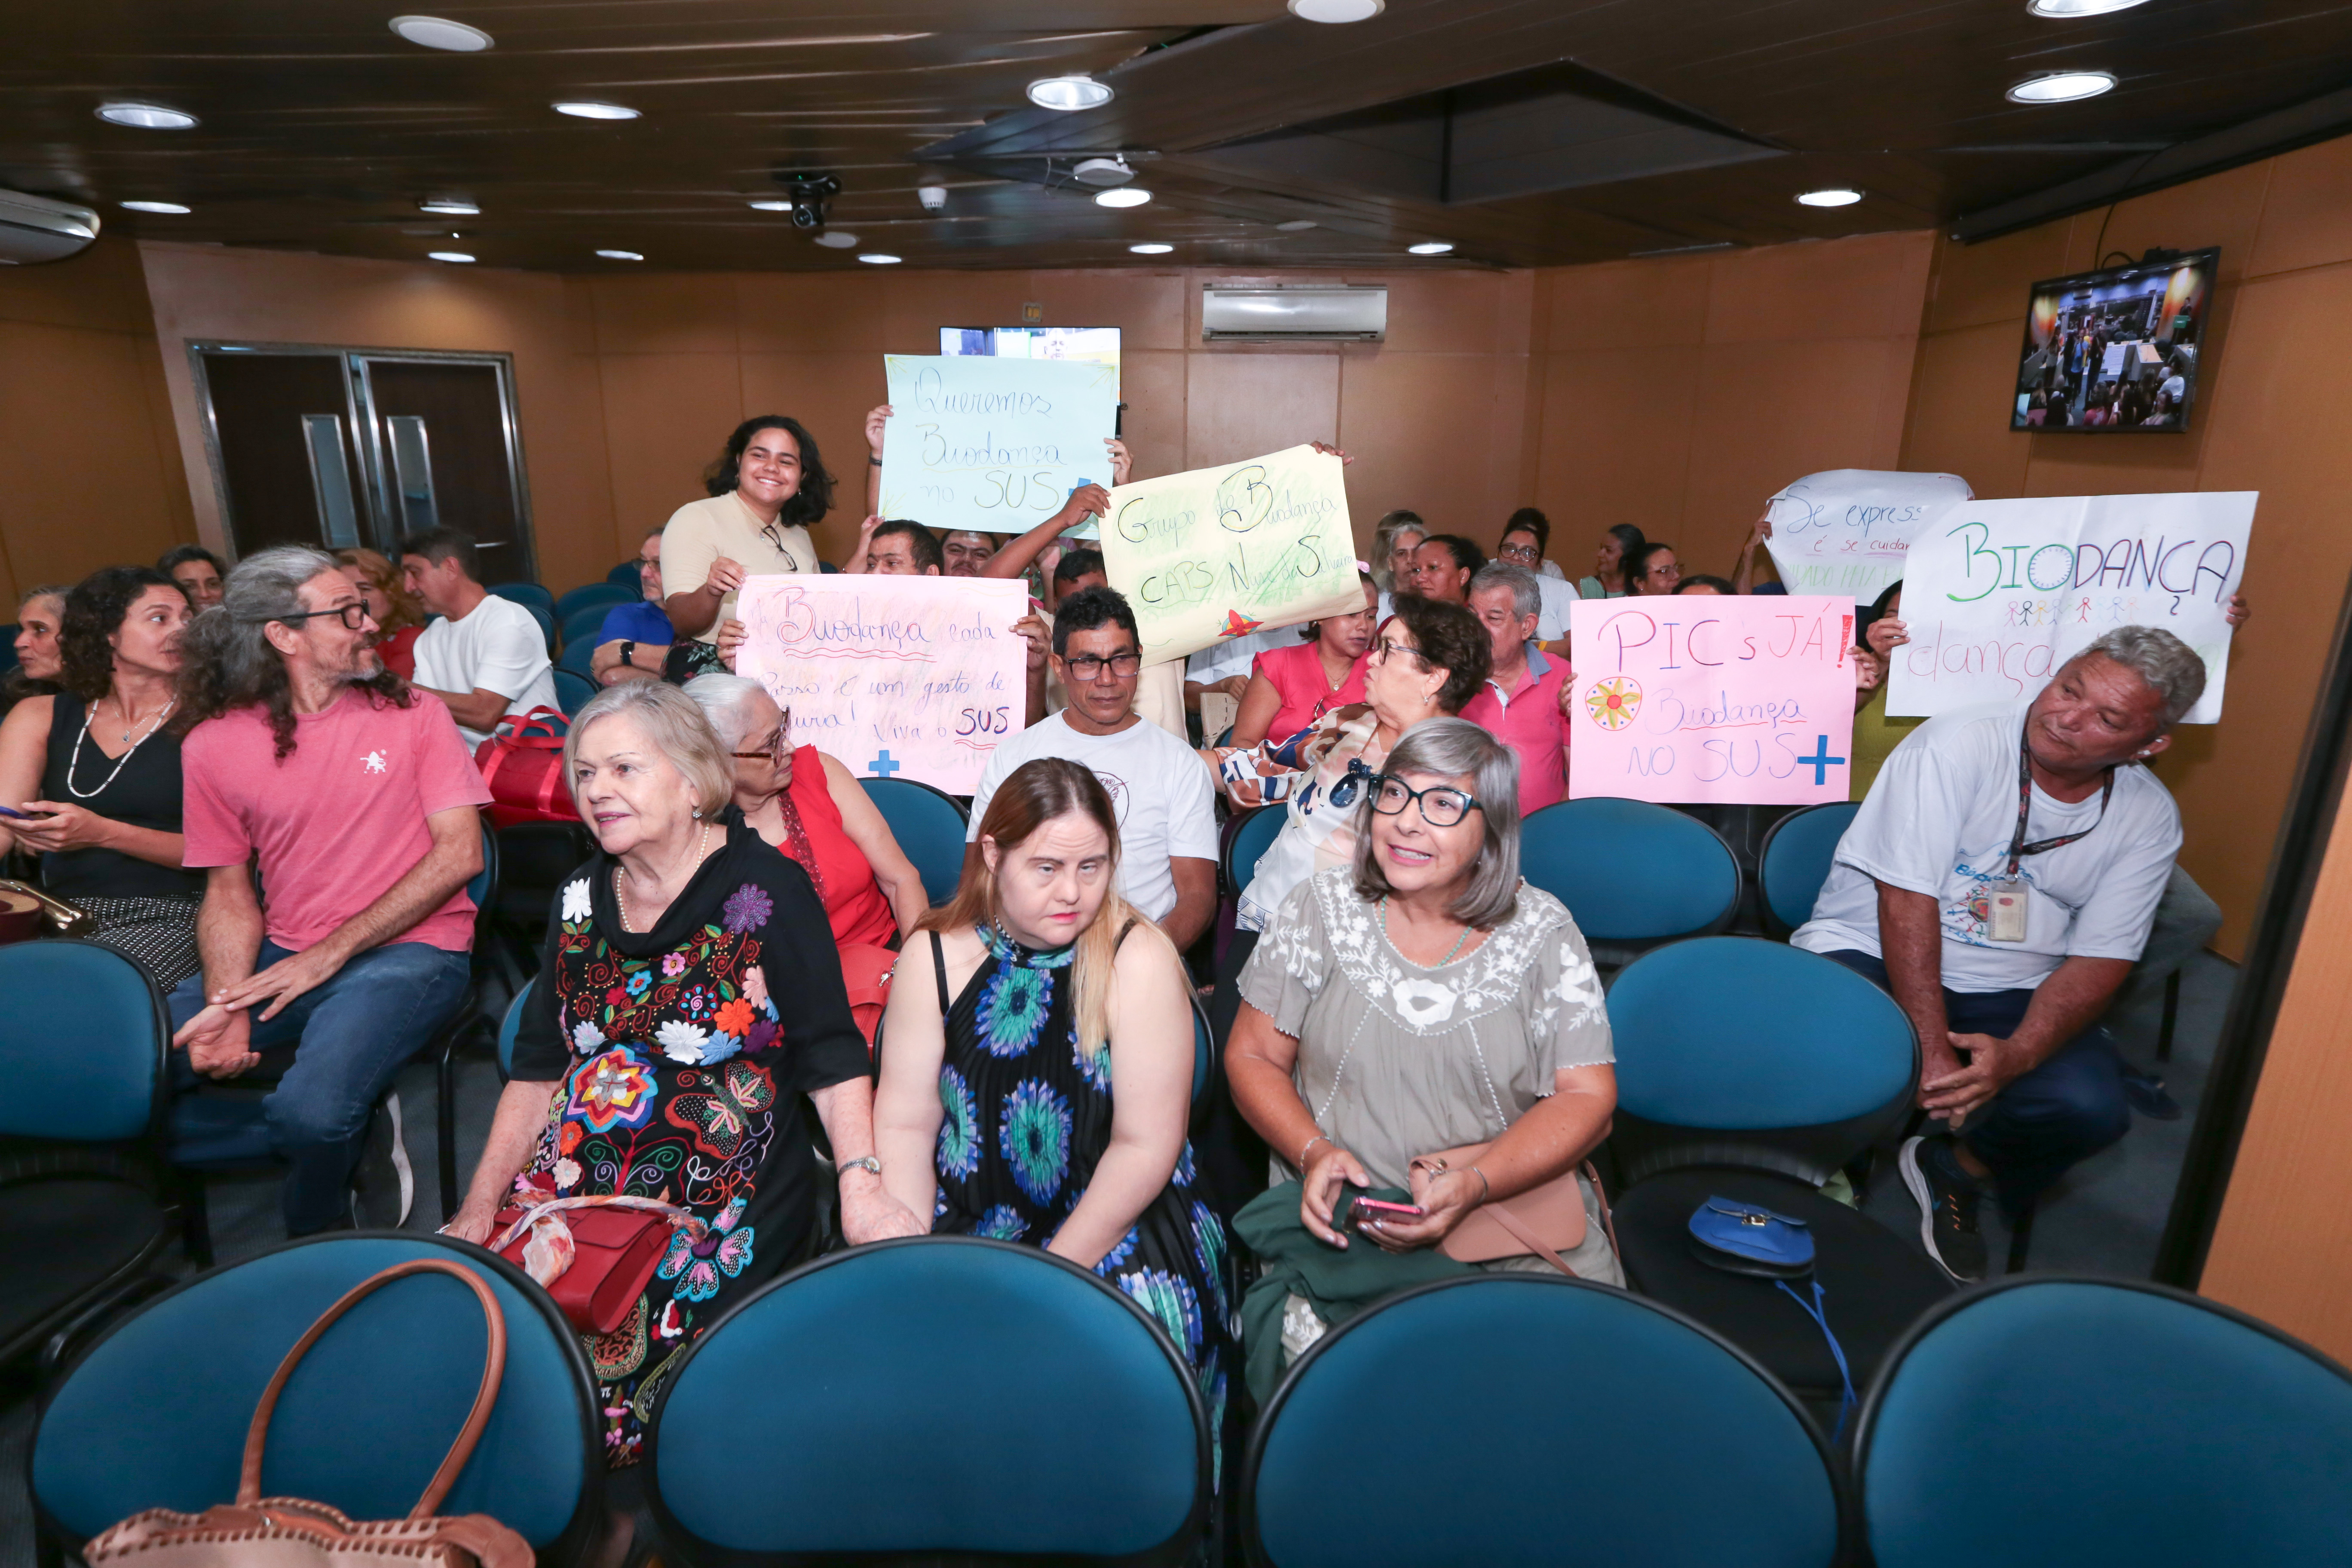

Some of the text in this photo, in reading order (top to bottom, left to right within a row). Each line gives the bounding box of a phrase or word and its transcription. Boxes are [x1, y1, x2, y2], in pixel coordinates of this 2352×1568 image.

[915, 367, 1053, 418] Queremos
[916, 423, 1068, 466] Biodança
[920, 470, 1060, 511] no SUS
[1118, 466, 1337, 548] Grupo de Biodança
[1786, 485, 1831, 533] Se
[1813, 535, 1911, 552] é se cuidar
[1141, 535, 1354, 603] CAPS Nise da Silveira
[1945, 522, 2234, 616] BIODANÇA
[773, 585, 931, 650] Biodança
[949, 611, 996, 642] cada
[1768, 602, 1854, 669] JÁ!
[1907, 620, 2056, 698] dança
[833, 673, 859, 696] é
[868, 681, 904, 697] um
[914, 671, 970, 715] gesto
[986, 671, 1005, 691] de
[1645, 688, 1808, 735] Biodança
[781, 699, 1010, 742] ura! Viva o SUS
[1628, 733, 1797, 781] NO SUS
